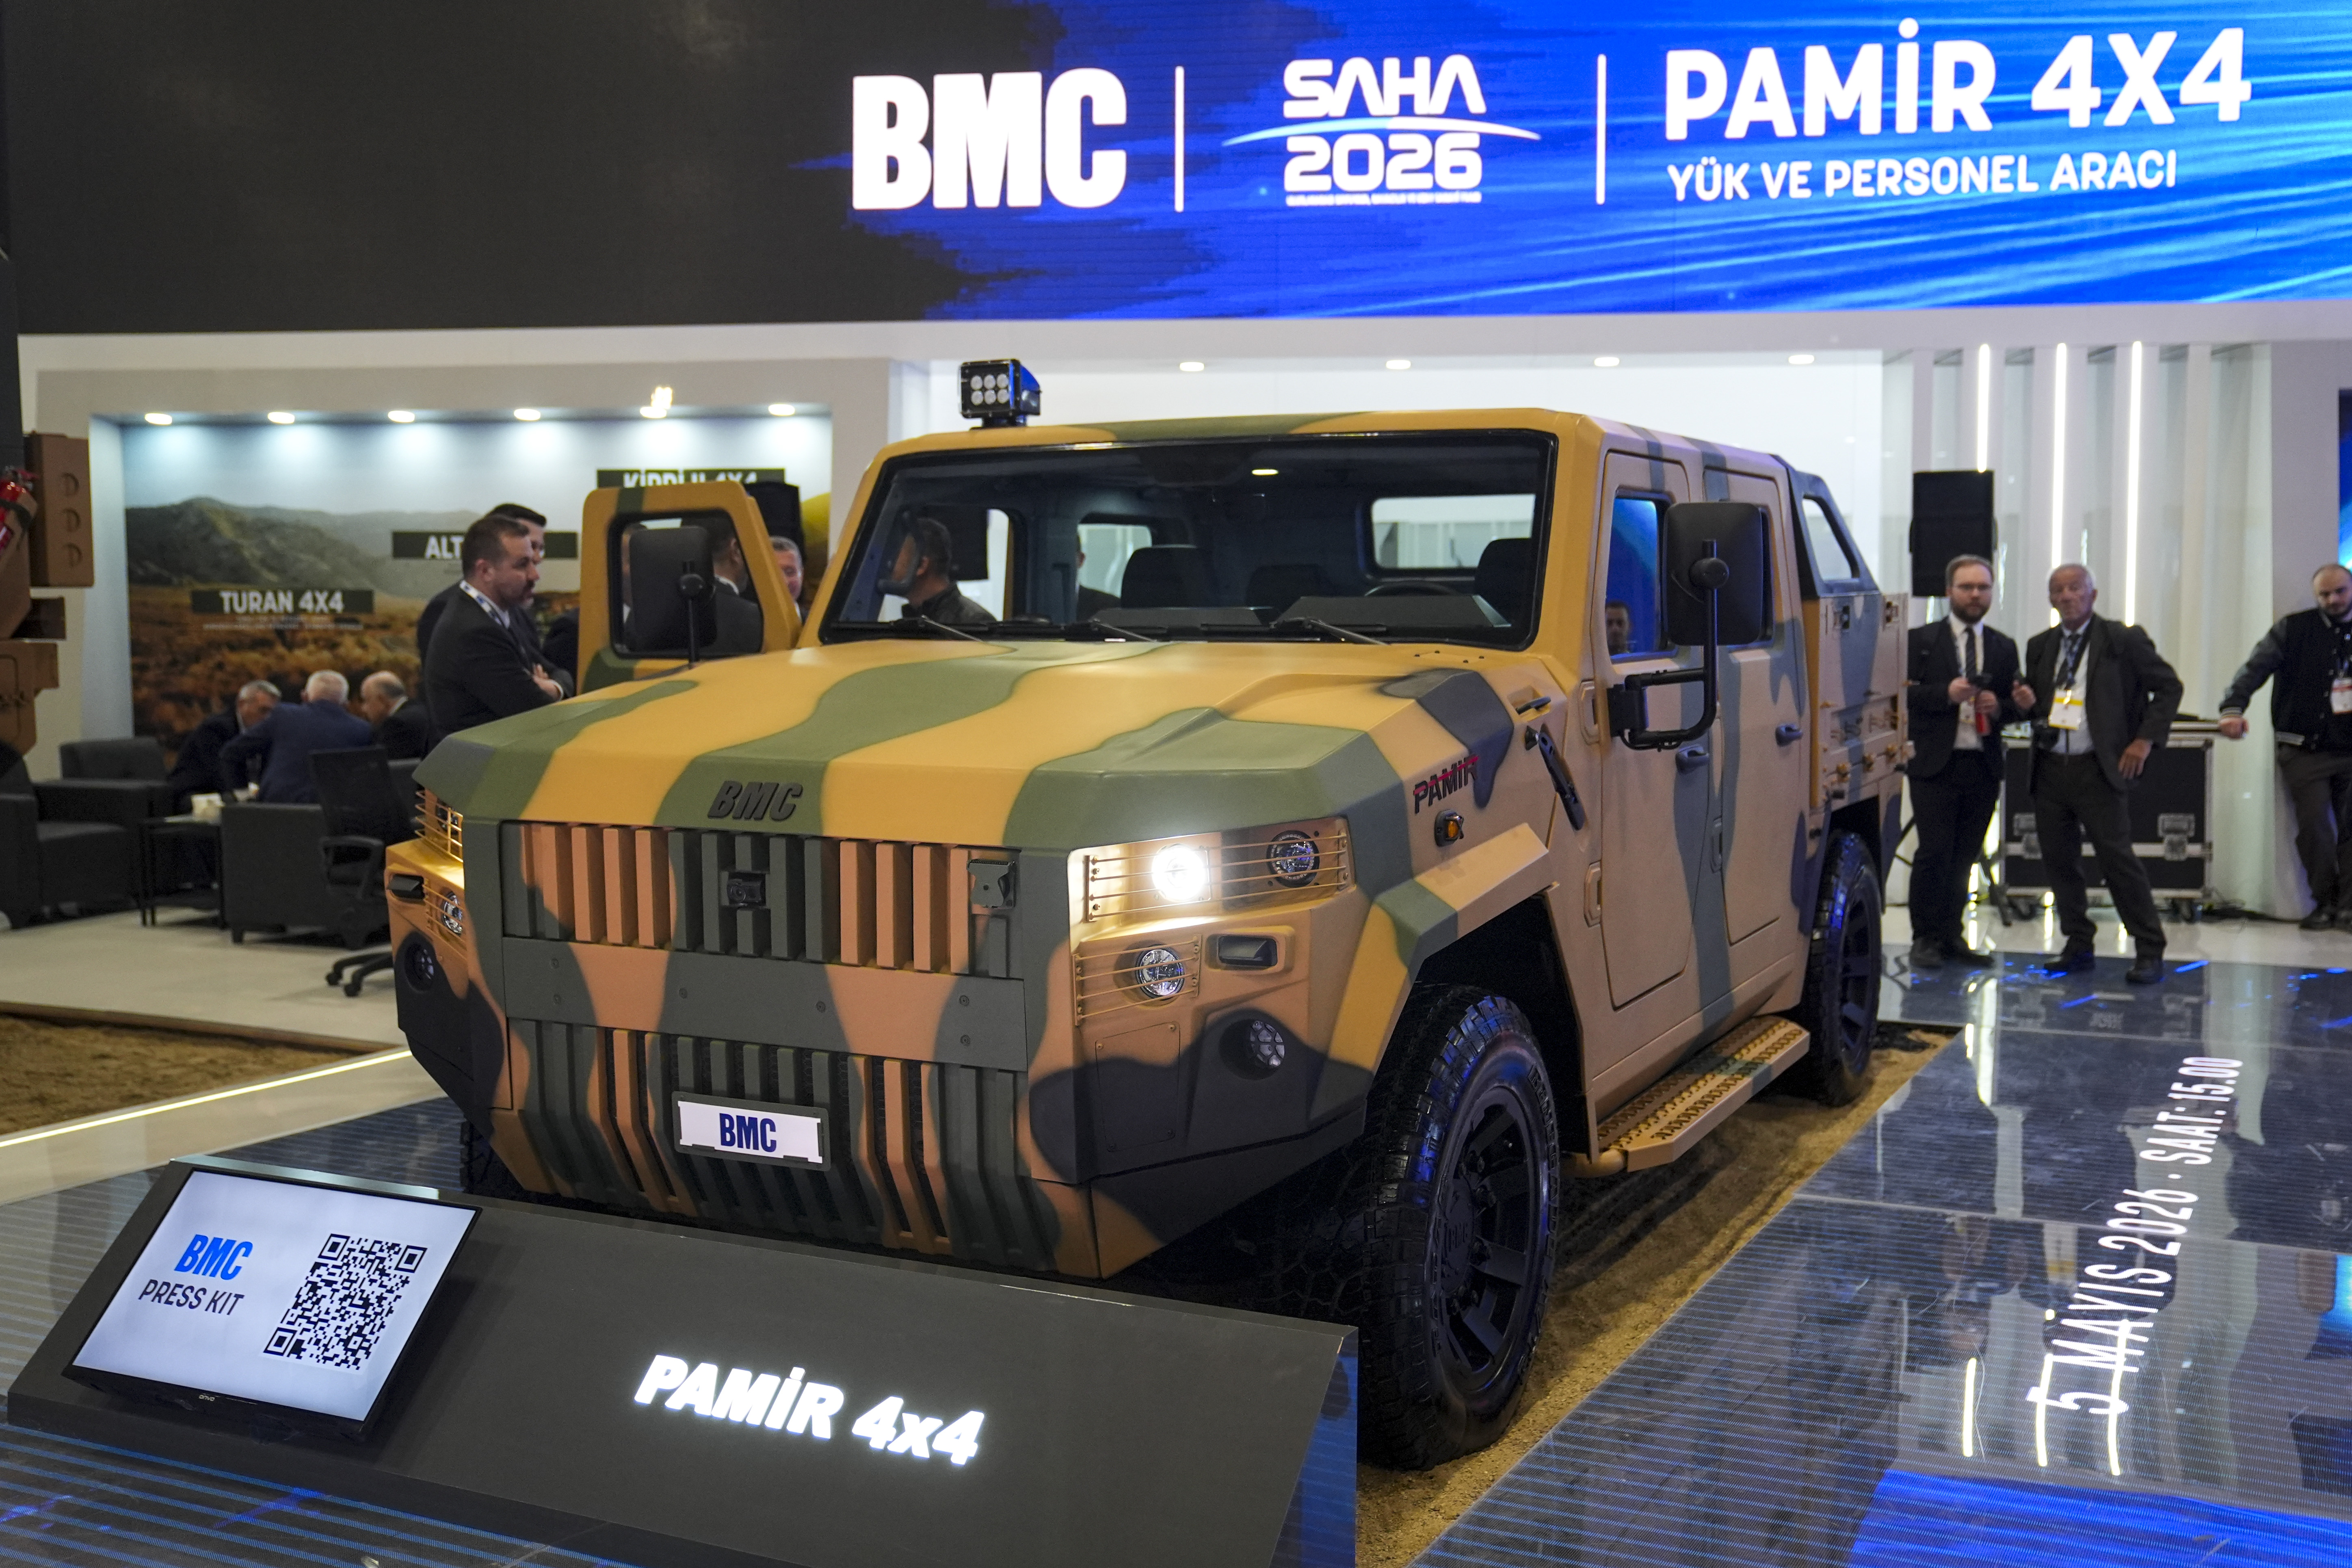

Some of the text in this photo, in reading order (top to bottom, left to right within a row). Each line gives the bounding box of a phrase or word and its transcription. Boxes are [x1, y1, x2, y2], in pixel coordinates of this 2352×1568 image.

[1283, 54, 1486, 118] SAHA
[1666, 18, 2251, 141] PAMİR 4X4
[852, 67, 1127, 210] BMC
[1284, 133, 1482, 192] 2026
[1667, 149, 2177, 201] YÜK VE PERSONEL ARACI
[220, 590, 345, 614] TURAN 4X4
[707, 781, 803, 821] BMC
[720, 1113, 776, 1153] BMC
[174, 1234, 253, 1280] BMC
[2025, 1056, 2243, 1415] 5 MAYIS 2026 SAAT: 15.00
[138, 1279, 245, 1315] PRESS KIT
[634, 1354, 985, 1465] PAMİR 4x4
